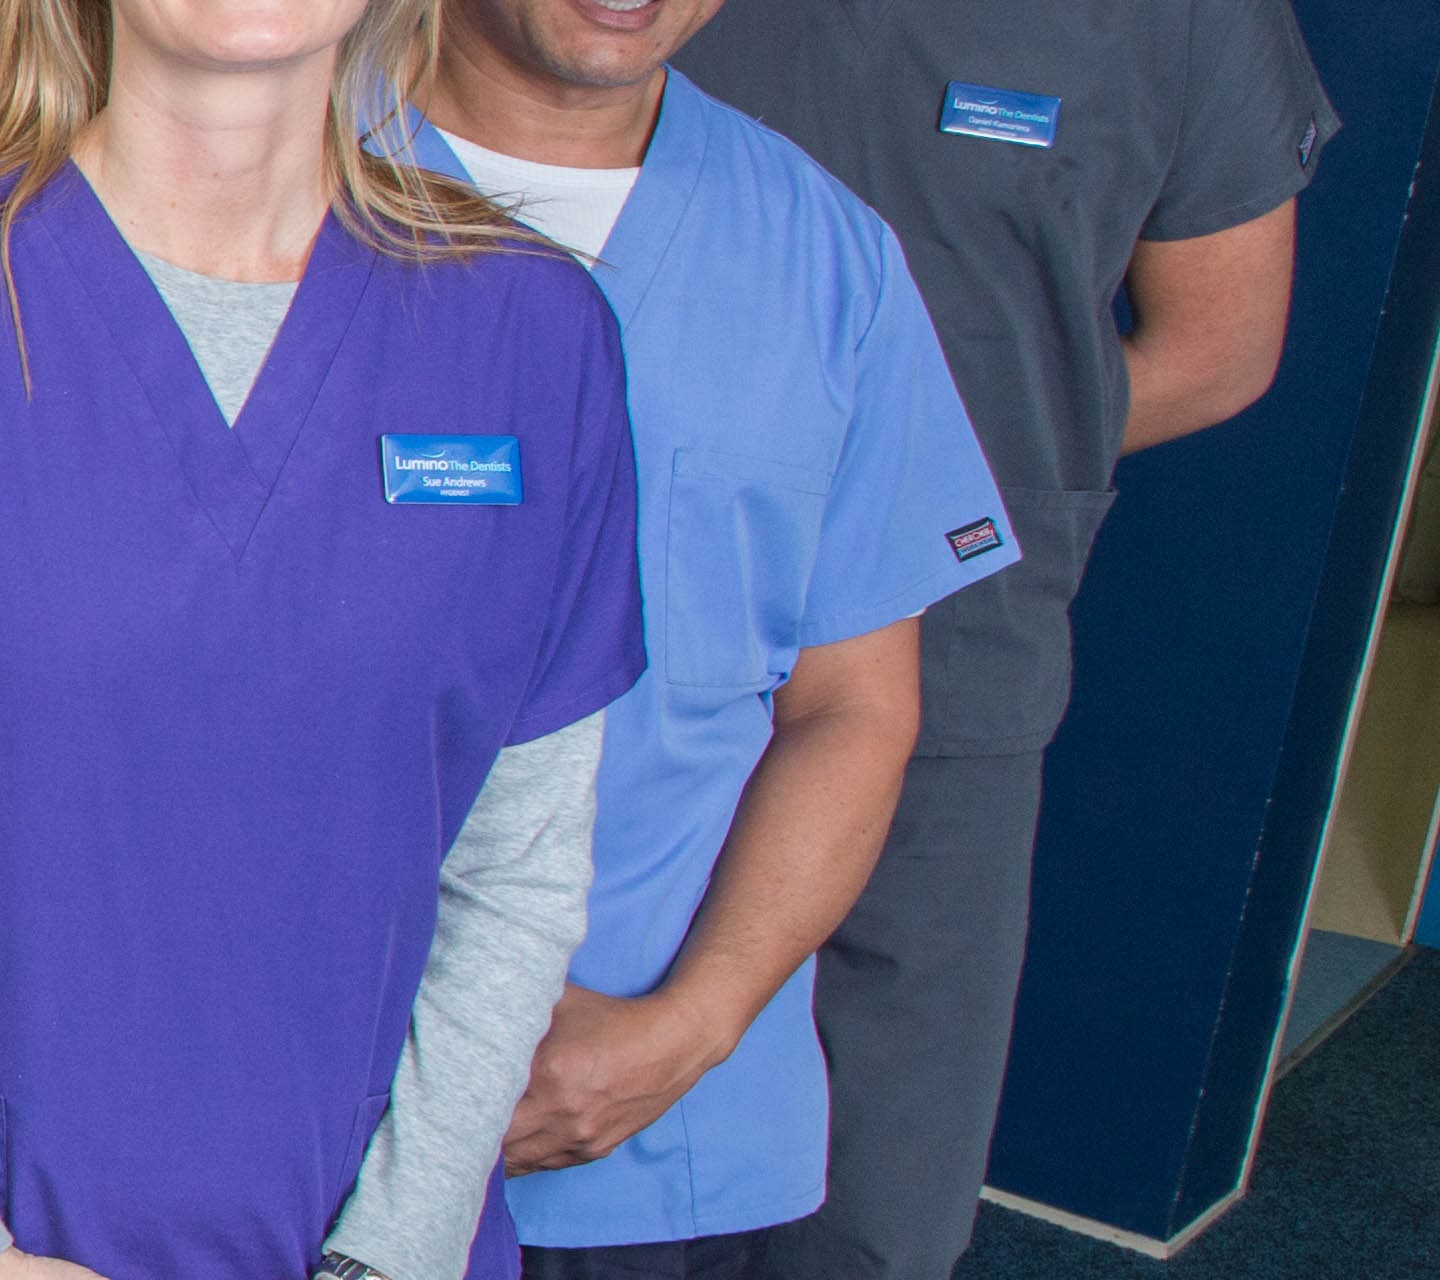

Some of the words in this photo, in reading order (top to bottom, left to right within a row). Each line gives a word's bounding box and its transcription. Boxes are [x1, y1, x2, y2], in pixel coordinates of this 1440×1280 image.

[954, 98, 997, 115] Lumino
[998, 108, 1014, 118] The
[1014, 111, 1049, 123] Dentists
[395, 455, 448, 471] Lumino
[448, 460, 469, 471] The
[470, 460, 511, 472] Dentists
[422, 476, 441, 487] Sue
[443, 477, 486, 487] Andrews
